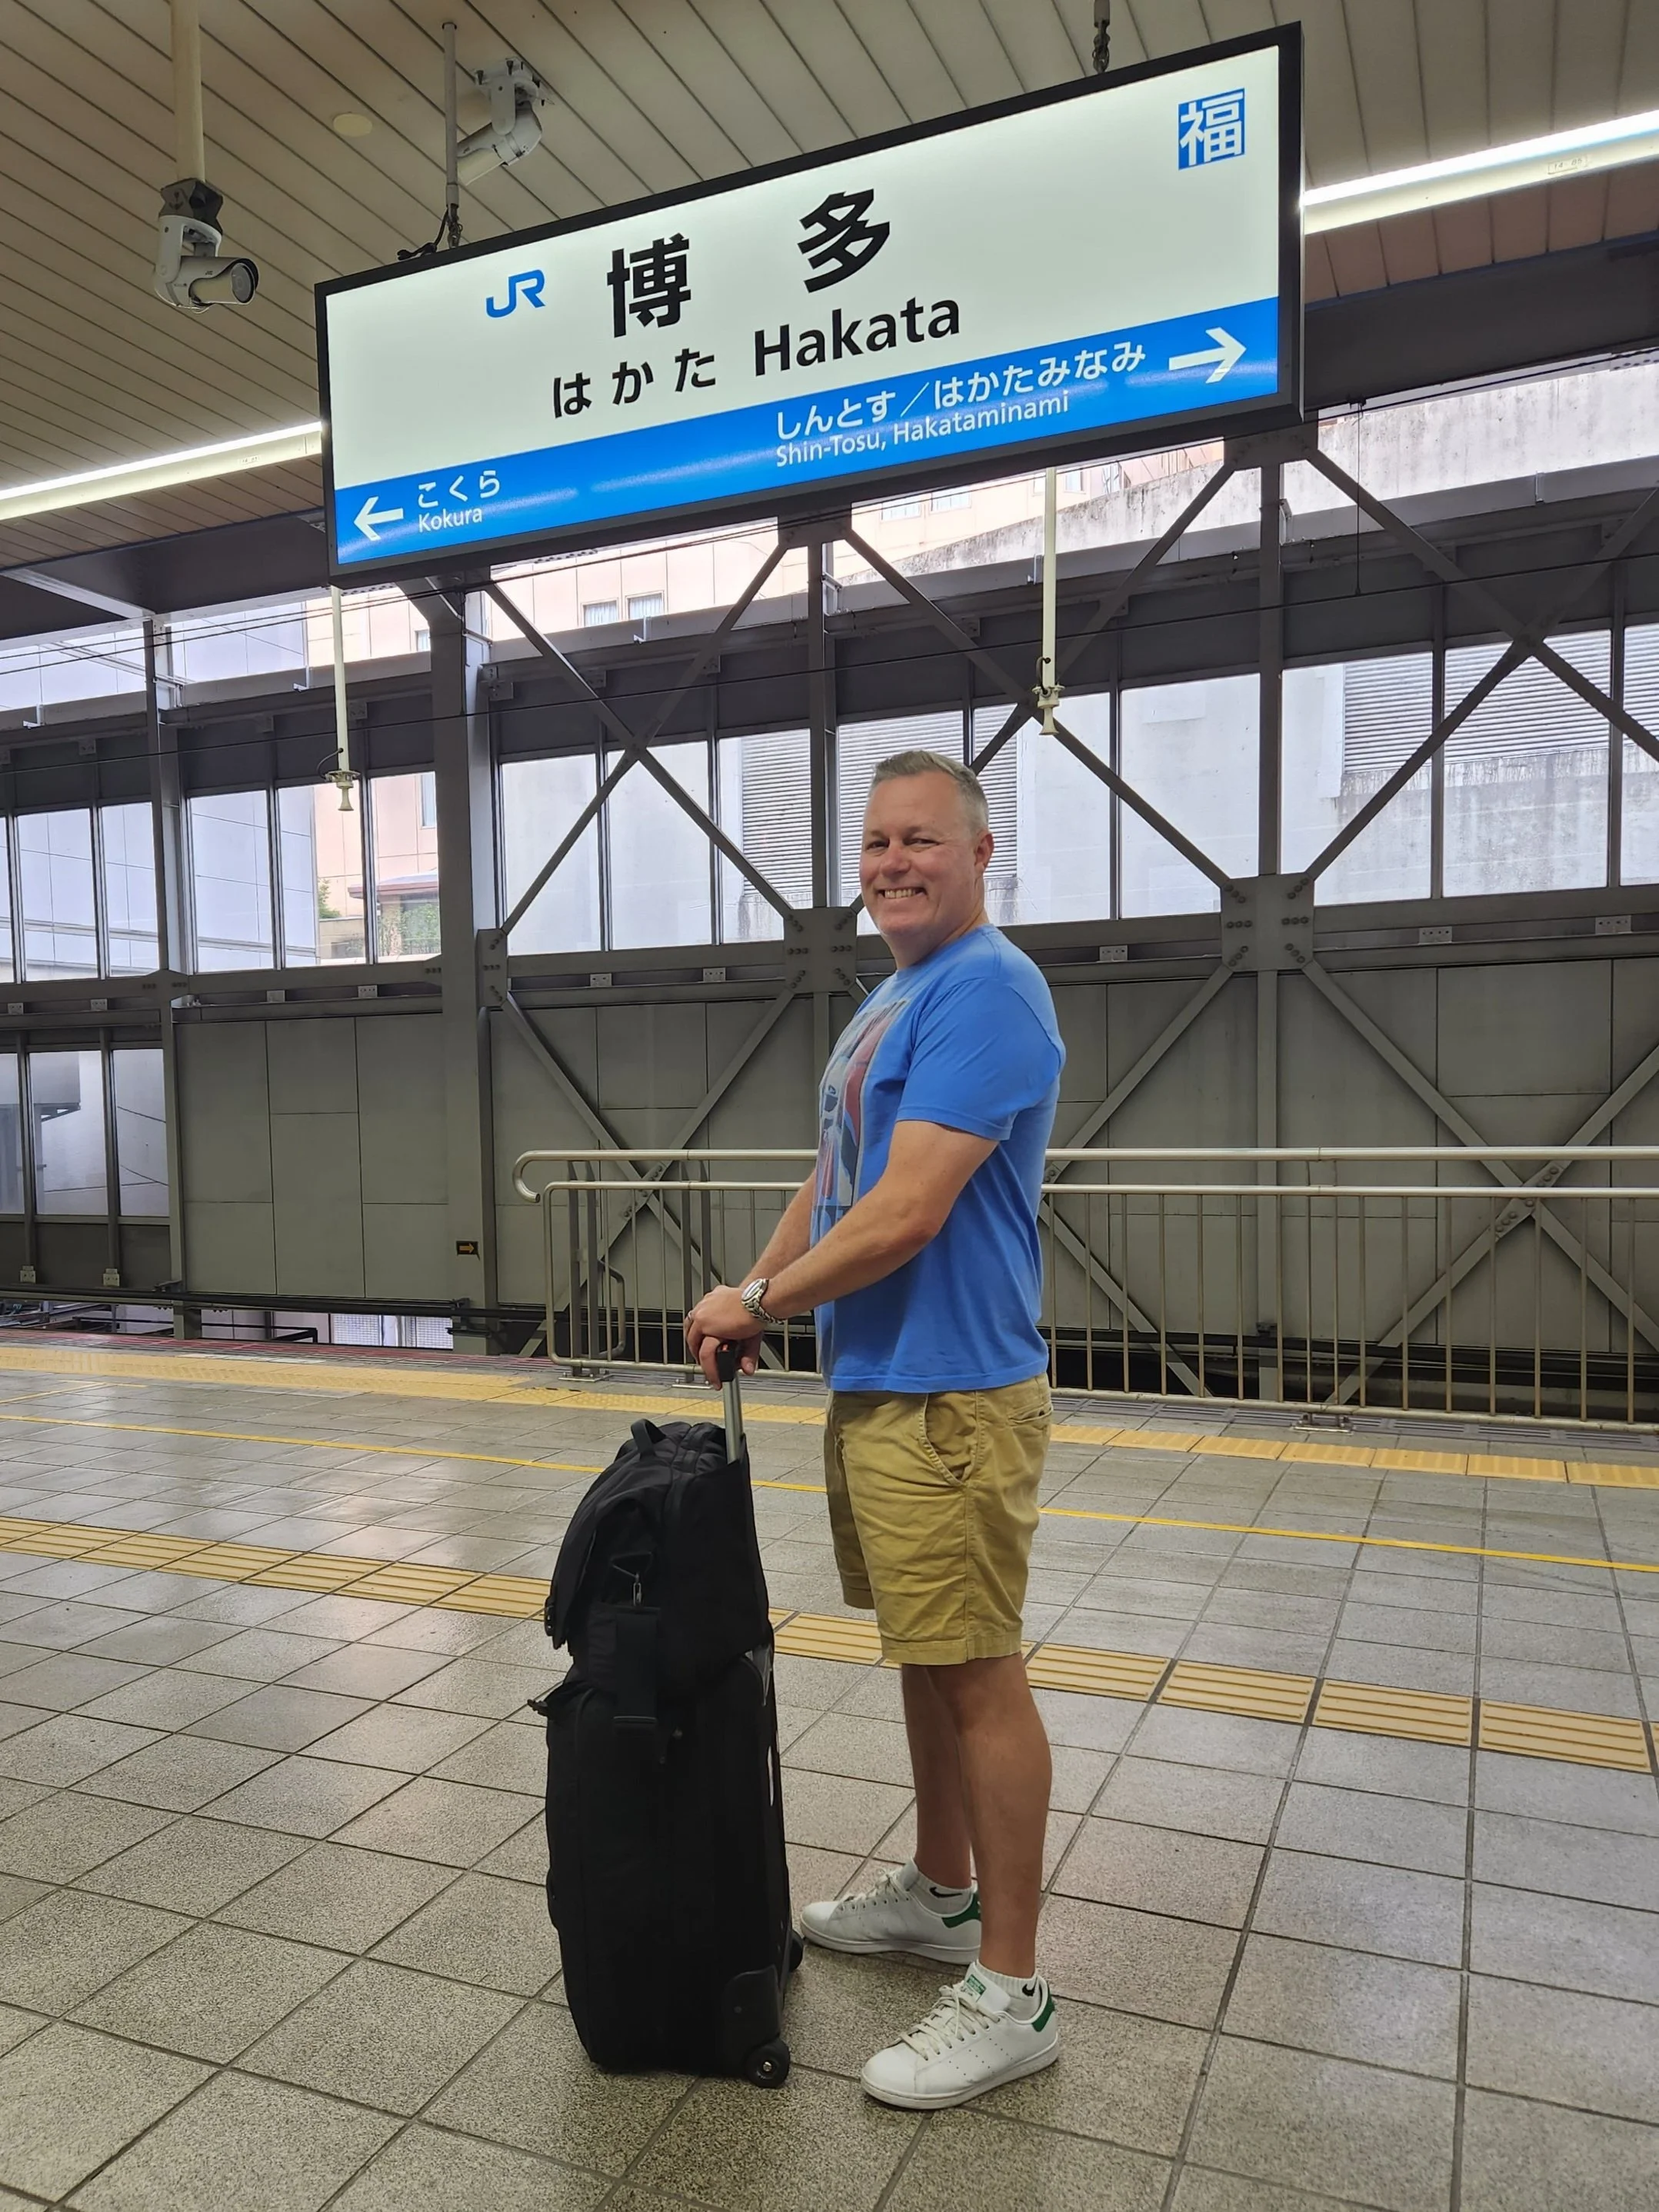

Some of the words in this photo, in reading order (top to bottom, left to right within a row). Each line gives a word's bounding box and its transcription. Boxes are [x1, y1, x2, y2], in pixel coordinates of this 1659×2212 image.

[1178, 88, 1244, 169] 福
[485, 269, 545, 318] JR
[606, 188, 890, 338] 博多
[755, 297, 960, 377] Hakata
[553, 348, 716, 418] はかた
[776, 431, 887, 468] Shin-Tosu,
[893, 389, 1069, 445] Hakataminami
[418, 470, 500, 508] こくら
[418, 508, 483, 533] Kokura
